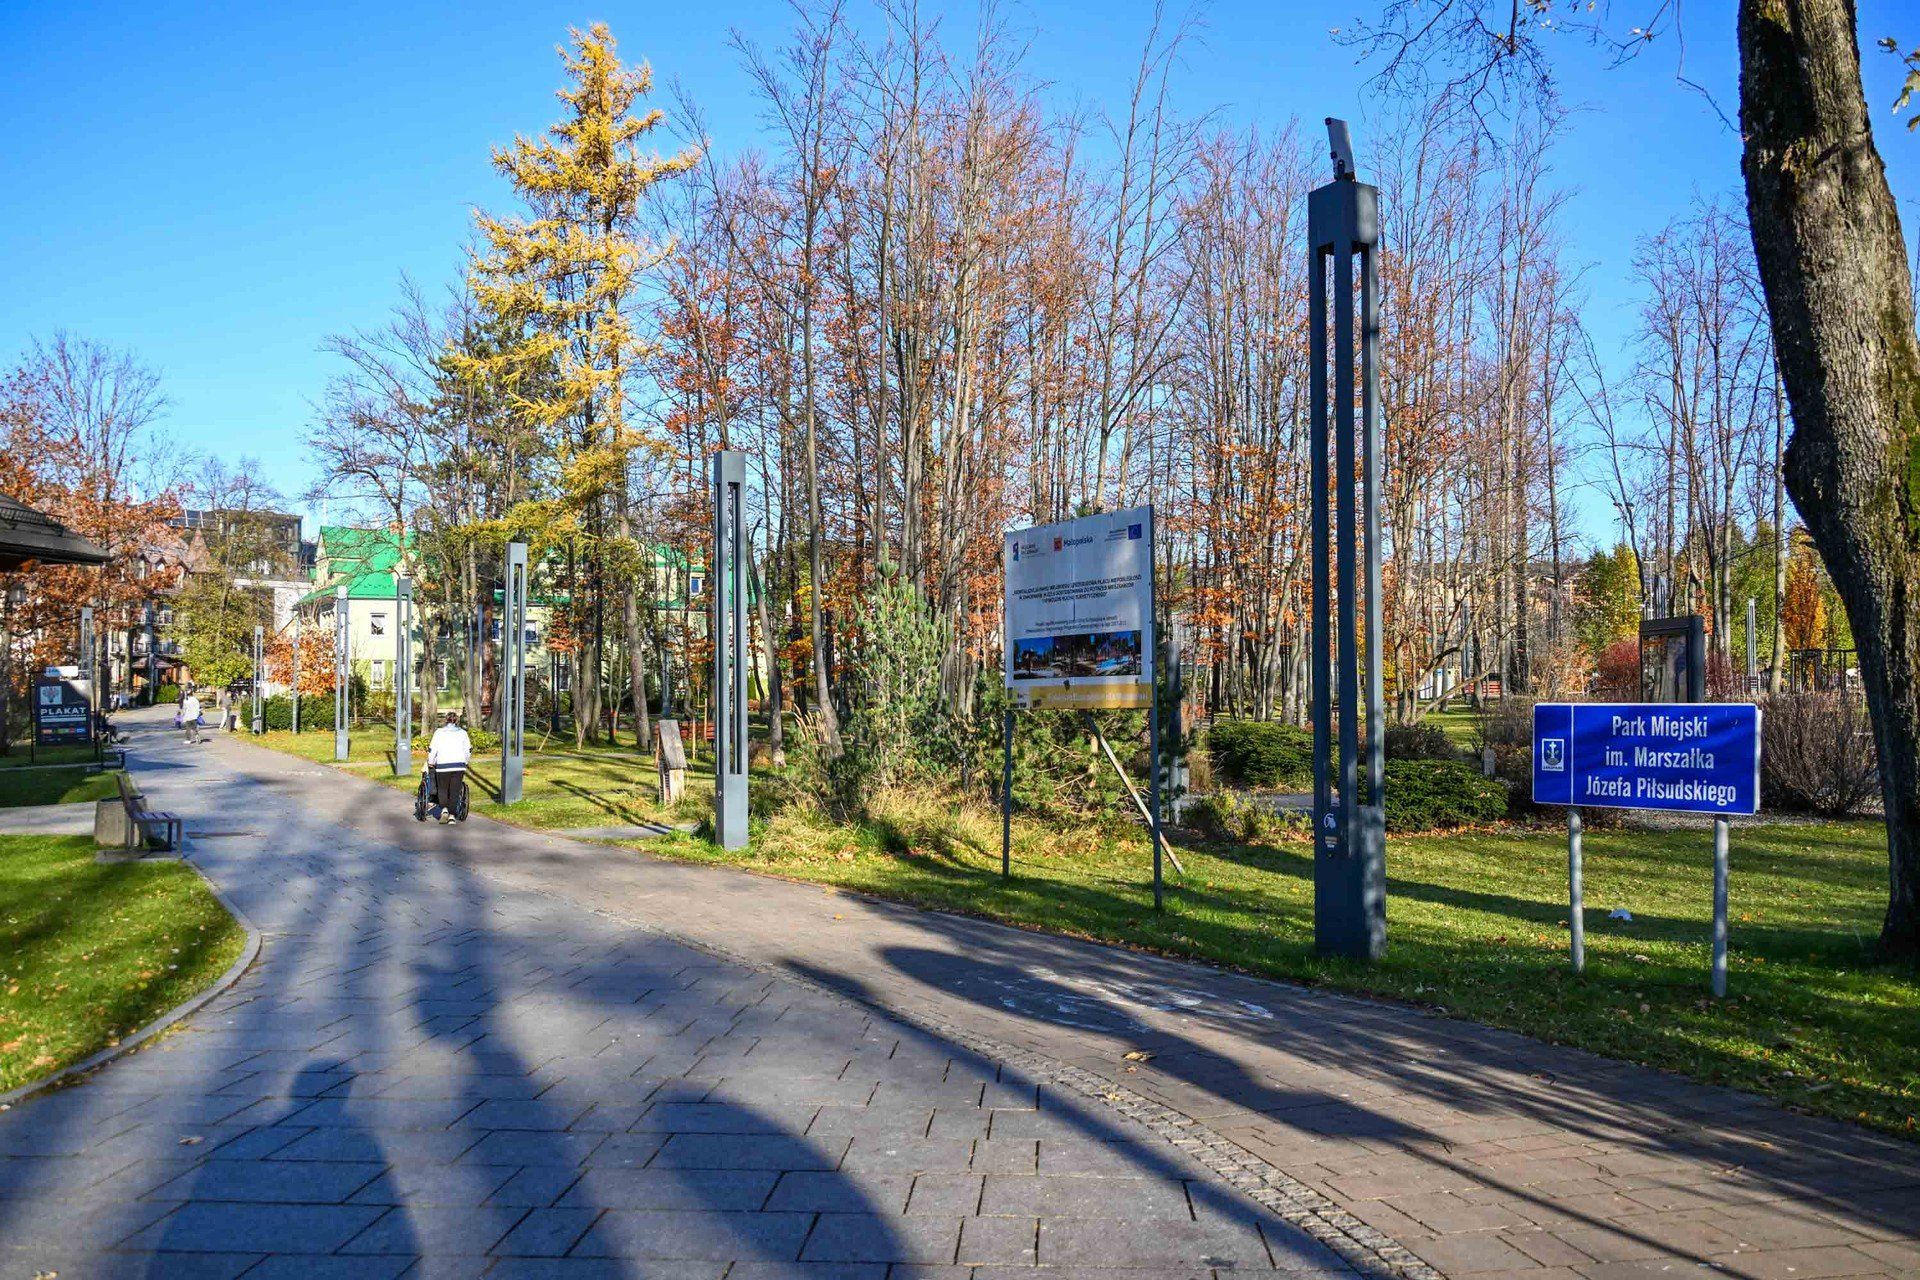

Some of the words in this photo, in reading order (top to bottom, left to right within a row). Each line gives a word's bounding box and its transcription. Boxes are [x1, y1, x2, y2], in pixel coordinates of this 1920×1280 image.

[41, 707, 86, 715] PLAKAT
[1612, 715, 1645, 737] Park
[1651, 715, 1708, 741] Miejski
[1605, 746, 1628, 767] im.
[1635, 746, 1715, 769] Marszałka
[1586, 775, 1631, 797] Józefa
[1637, 777, 1737, 806] Piłsudskiego
